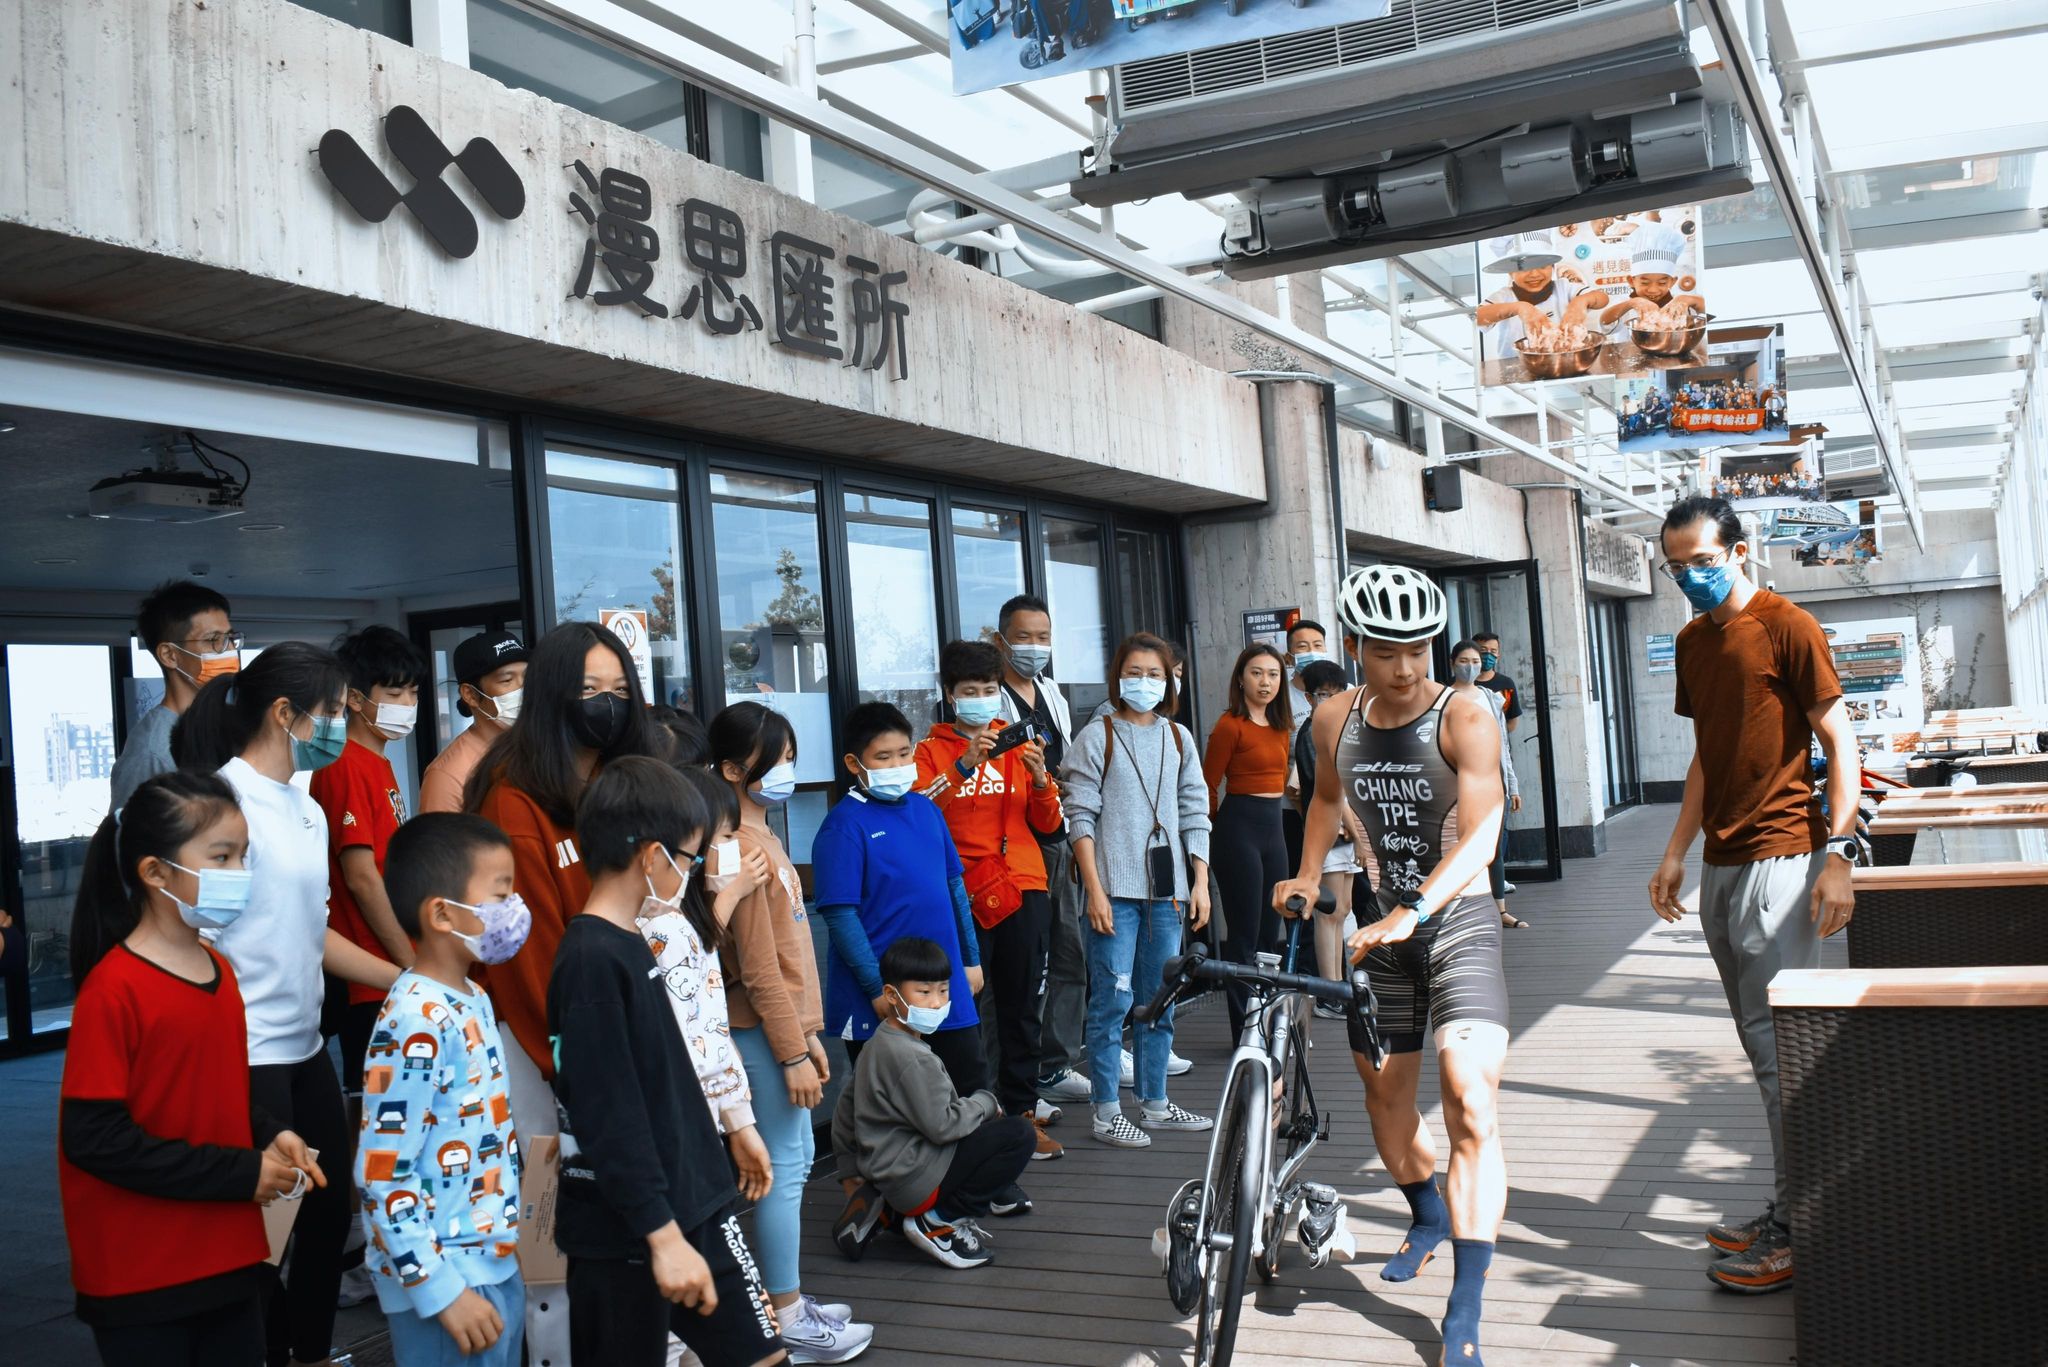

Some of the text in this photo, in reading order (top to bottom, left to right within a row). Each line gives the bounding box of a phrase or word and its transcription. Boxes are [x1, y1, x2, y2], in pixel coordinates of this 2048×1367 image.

[568, 158, 910, 381] 漫思匯所
[1351, 761, 1424, 773] atlas
[1354, 778, 1433, 801] CHIANG
[1377, 802, 1419, 826] TPE
[720, 1222, 775, 1339] PRODUCT TESTING
